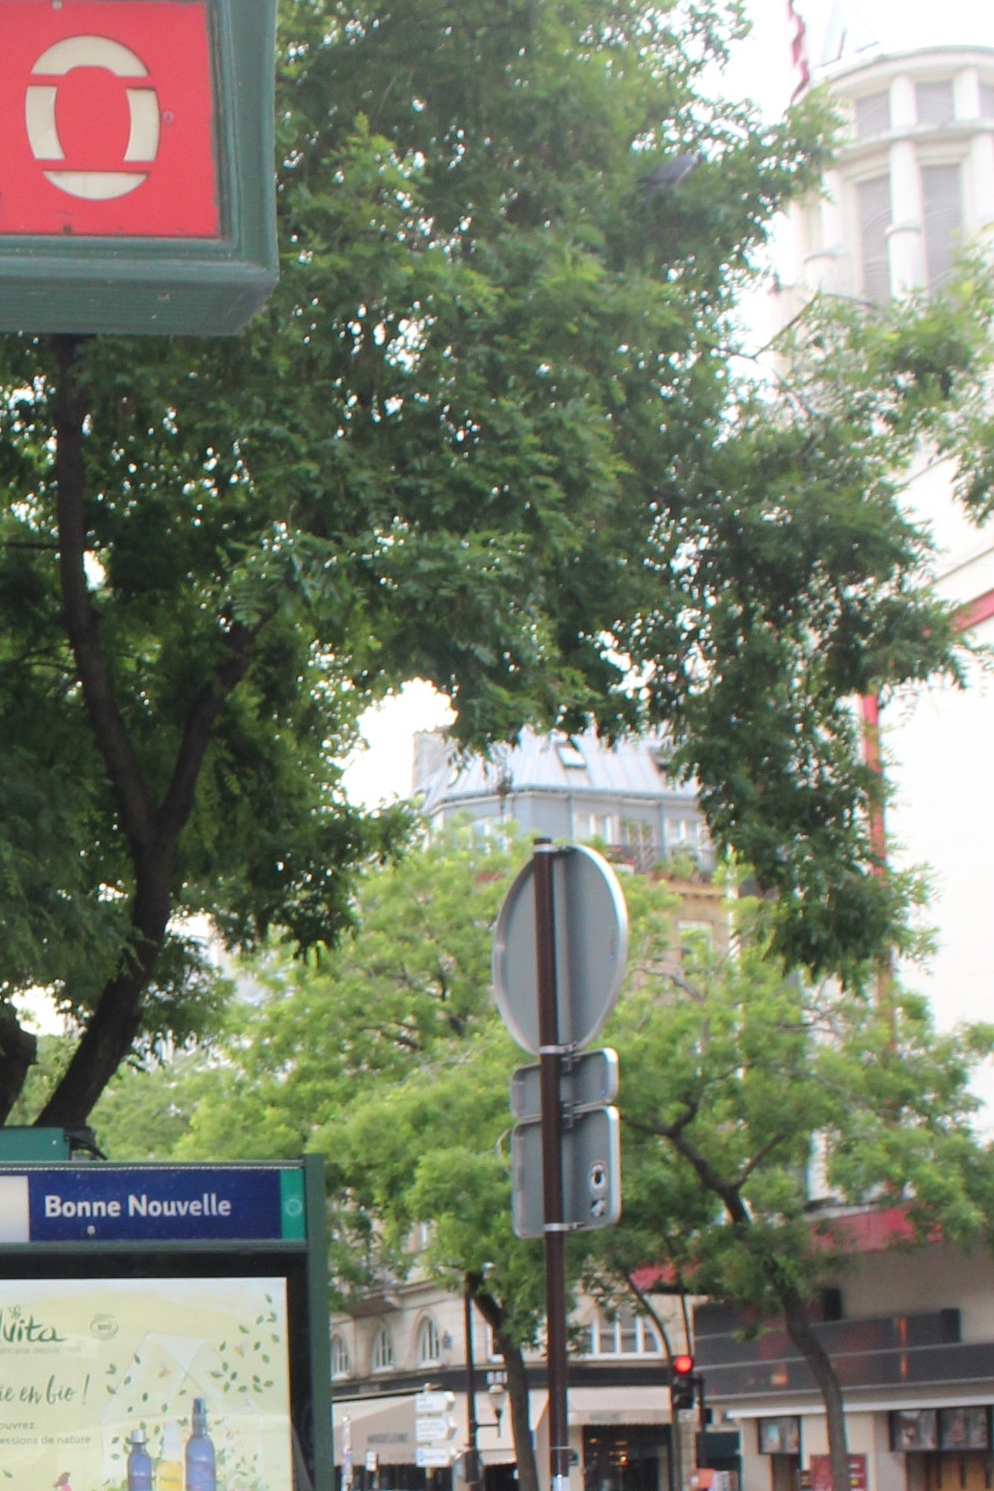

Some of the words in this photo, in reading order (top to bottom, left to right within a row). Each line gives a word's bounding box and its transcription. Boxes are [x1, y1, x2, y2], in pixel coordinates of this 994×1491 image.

[44, 1195, 121, 1218] Bonne
[128, 1193, 232, 1216] Nouvelle
[19, 1385, 43, 1404] en
[46, 1374, 75, 1404] bio
[41, 1434, 55, 1444] de
[57, 1434, 91, 1444] nature
